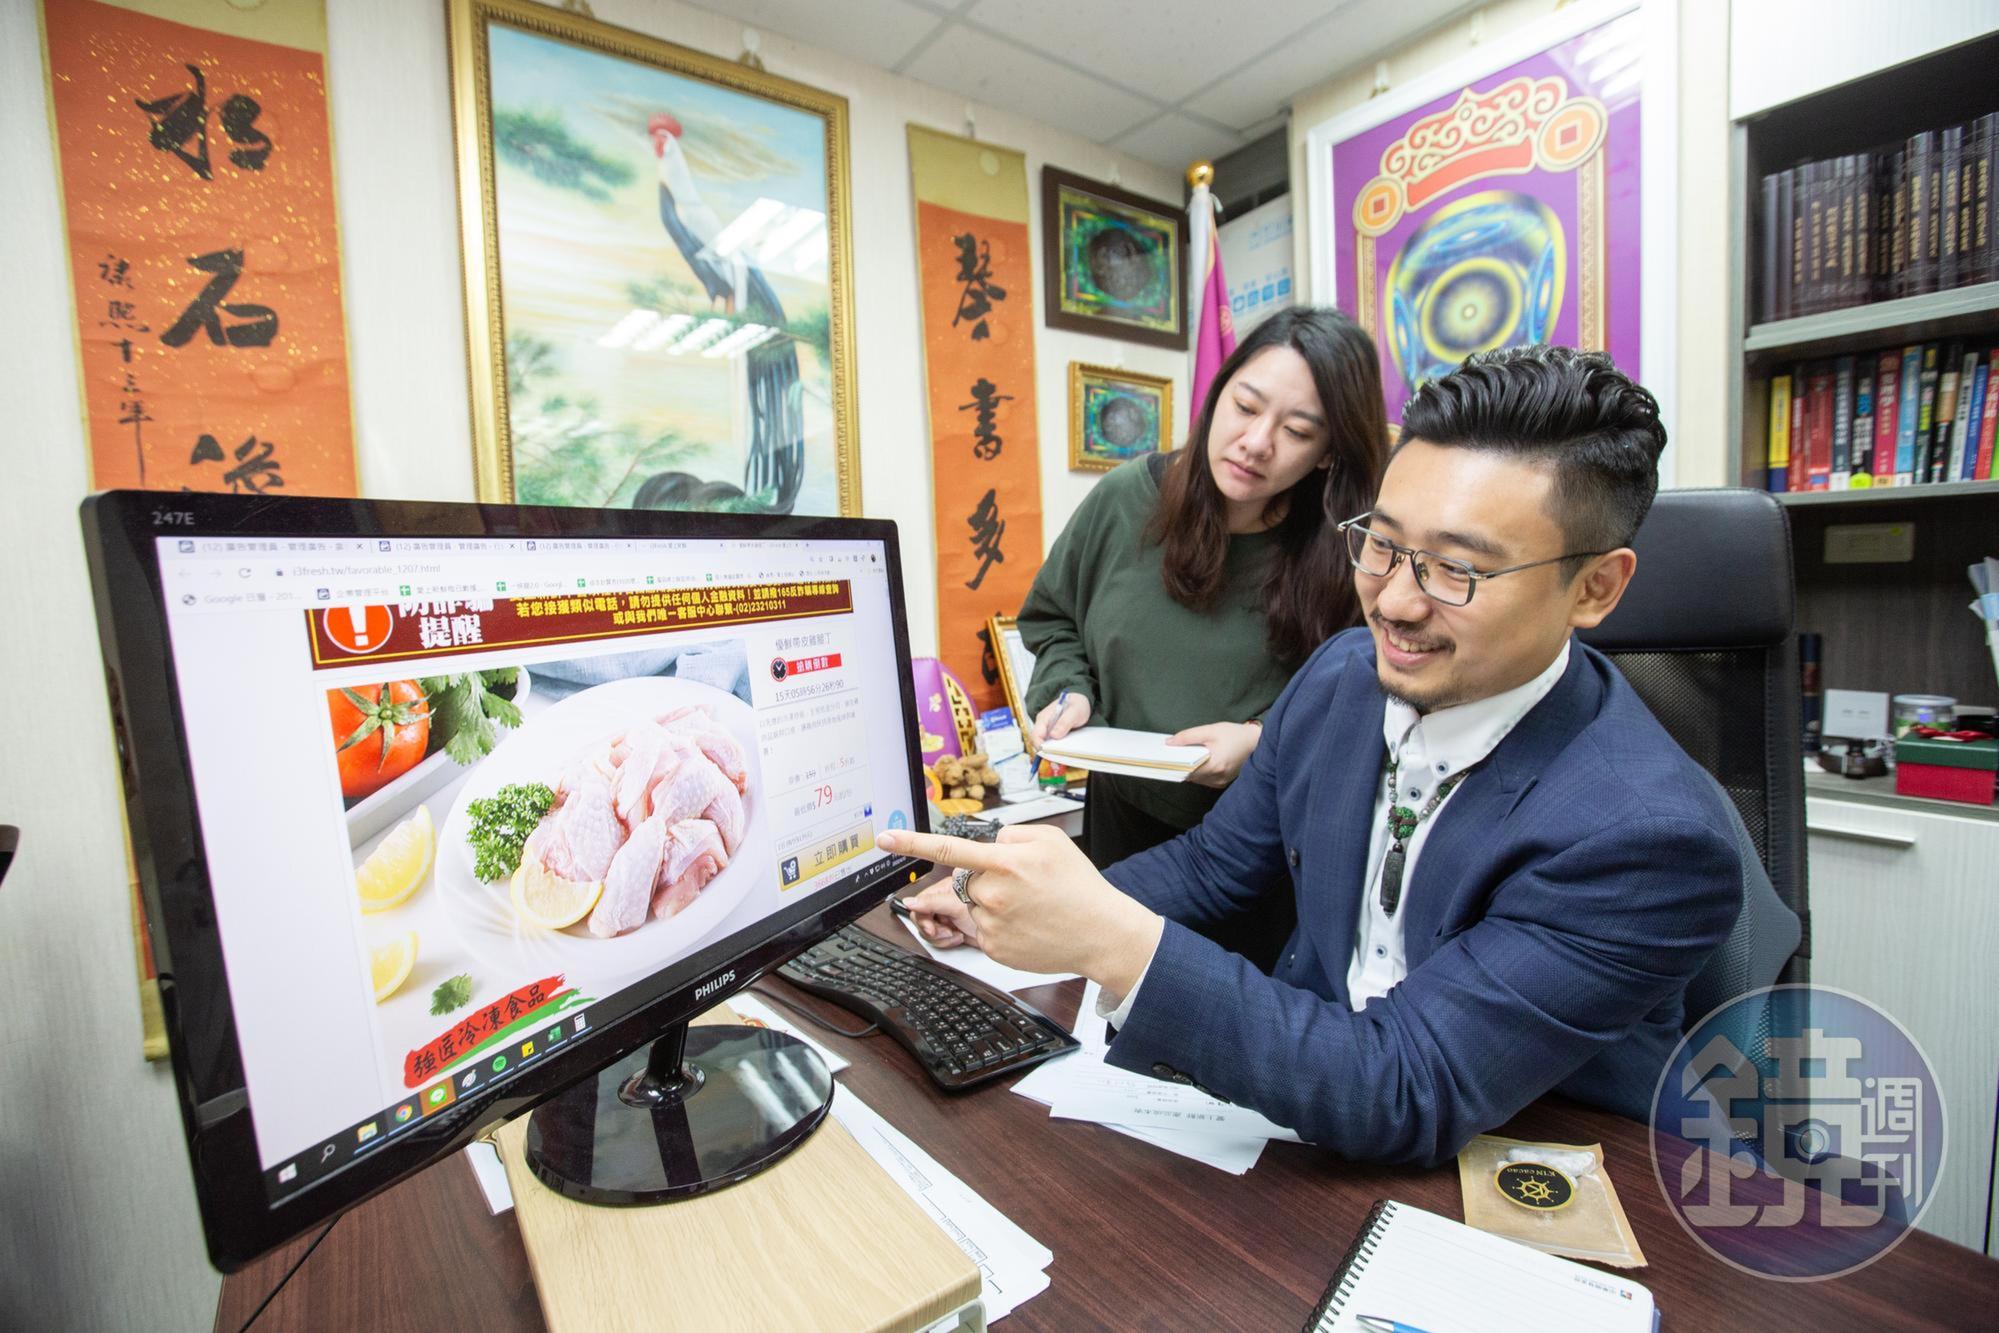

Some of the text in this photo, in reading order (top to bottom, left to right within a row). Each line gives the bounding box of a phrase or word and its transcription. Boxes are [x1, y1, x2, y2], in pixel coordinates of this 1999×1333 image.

[152, 511, 195, 525] 247E
[419, 614, 483, 649] 提醒
[814, 784, 833, 808] 79
[814, 833, 859, 867] 立即購買
[695, 969, 736, 1001] PHILIPS
